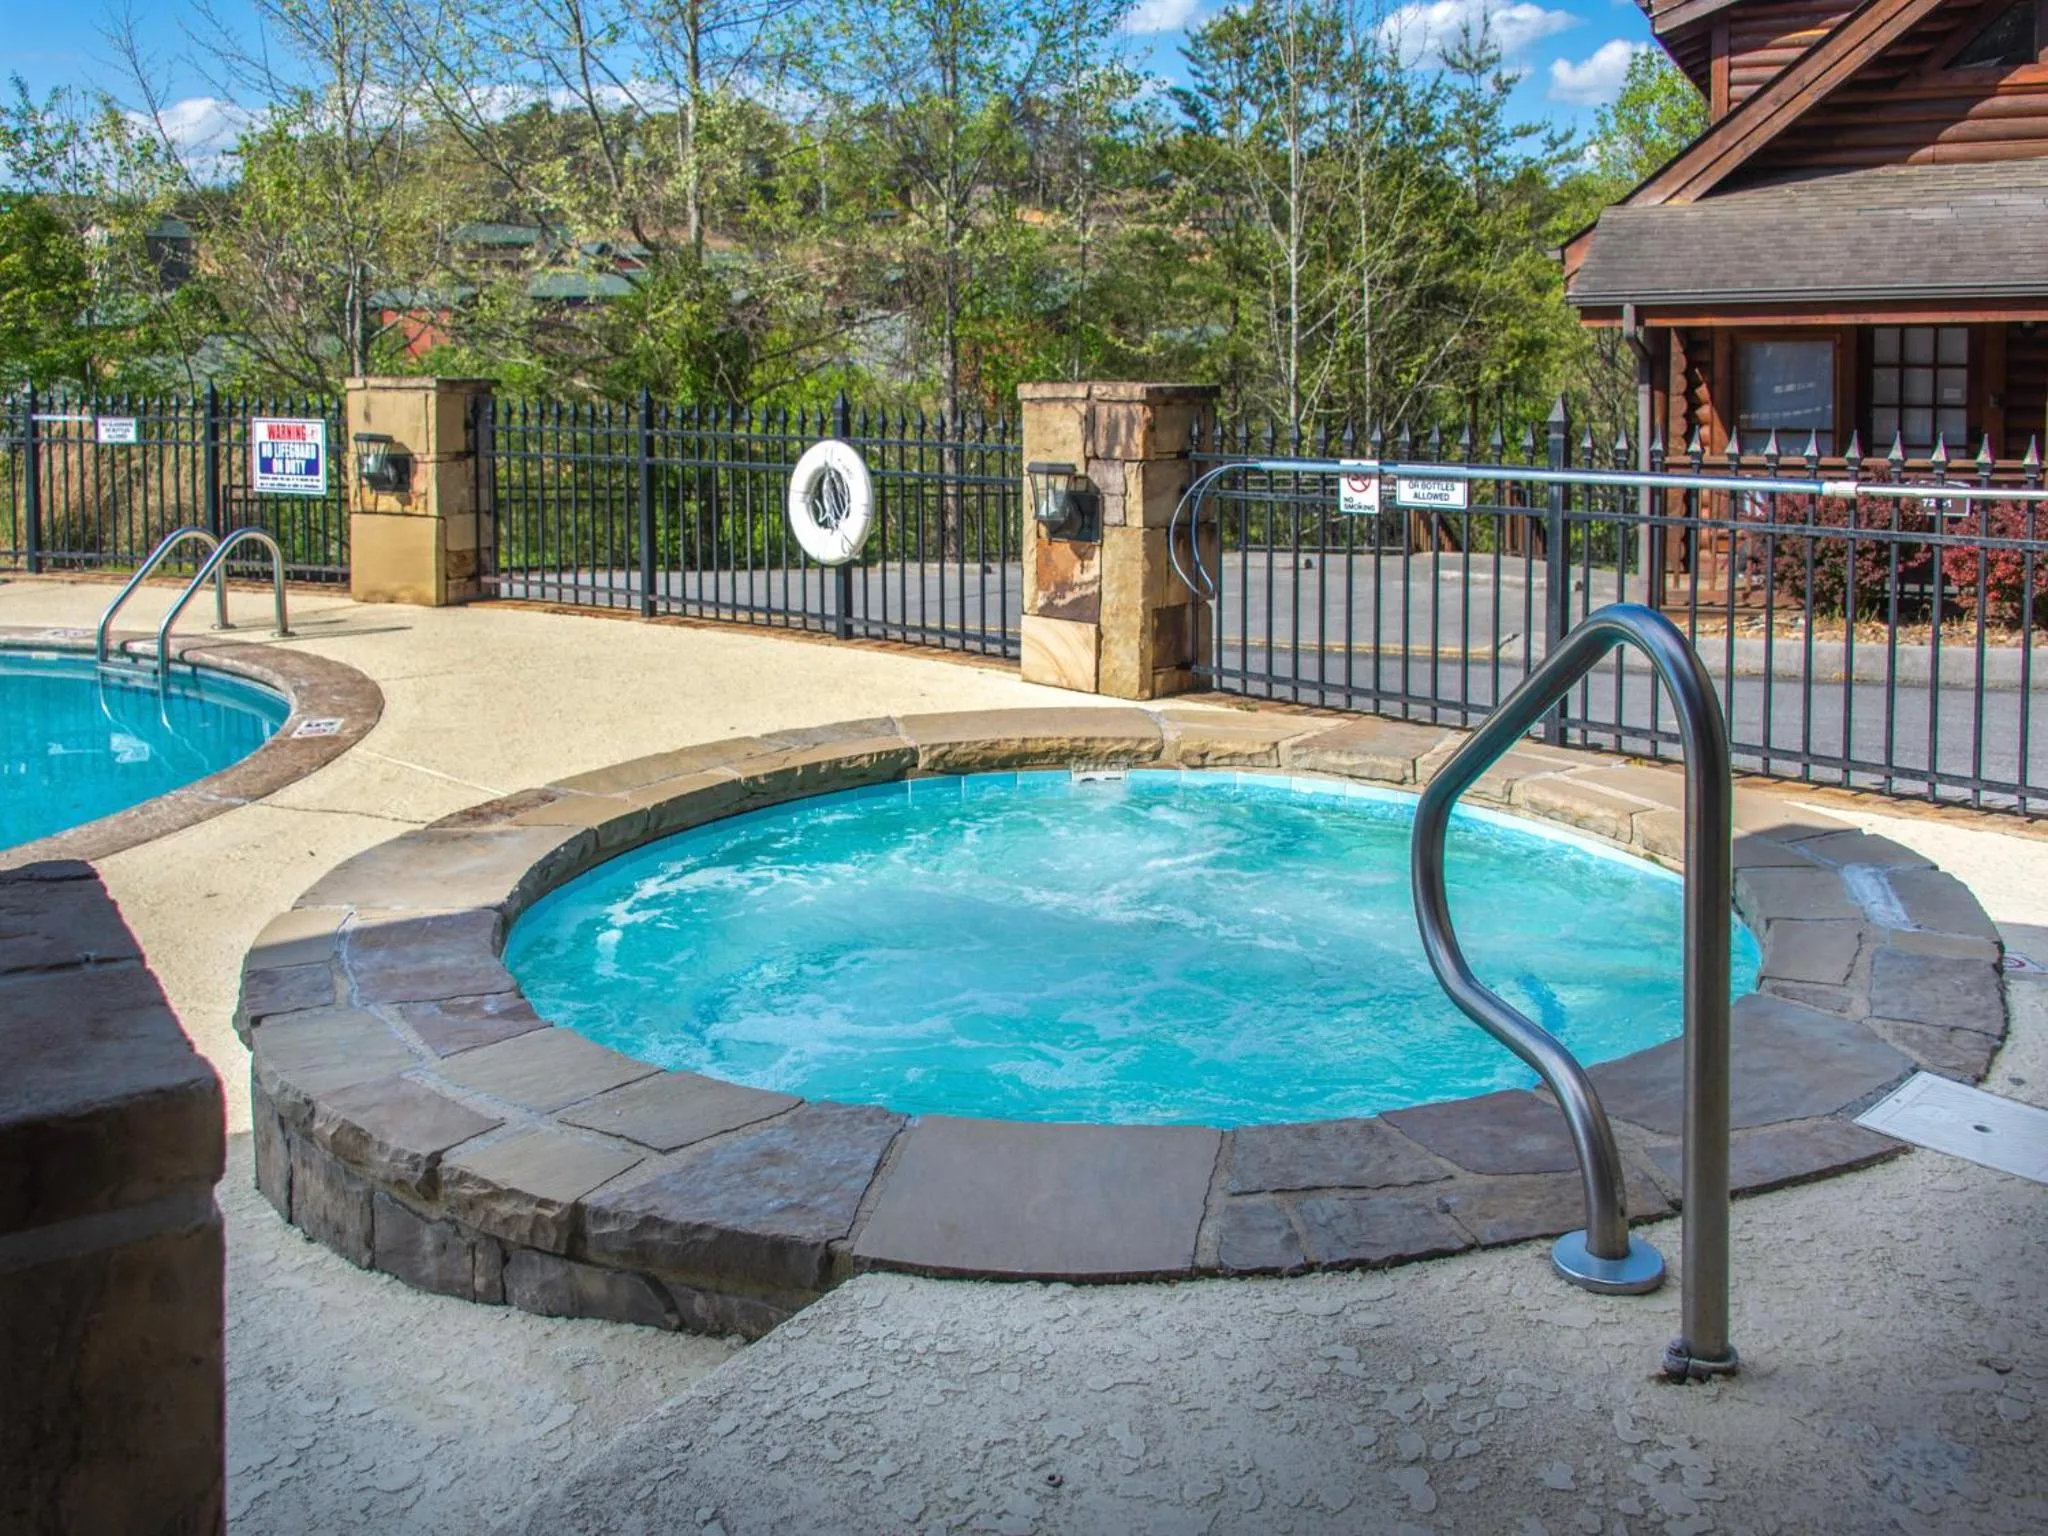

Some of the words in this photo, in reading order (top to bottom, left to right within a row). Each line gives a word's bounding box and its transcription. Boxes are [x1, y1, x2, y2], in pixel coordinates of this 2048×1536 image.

[267, 424, 306, 441] WARNING
[261, 443, 274, 459] NO
[275, 443, 317, 460] LIFEGUARD
[272, 459, 284, 475] ON
[285, 460, 306, 475] DUTY
[1413, 492, 1450, 502] ALLOWED
[1343, 503, 1376, 511] SMOKING
